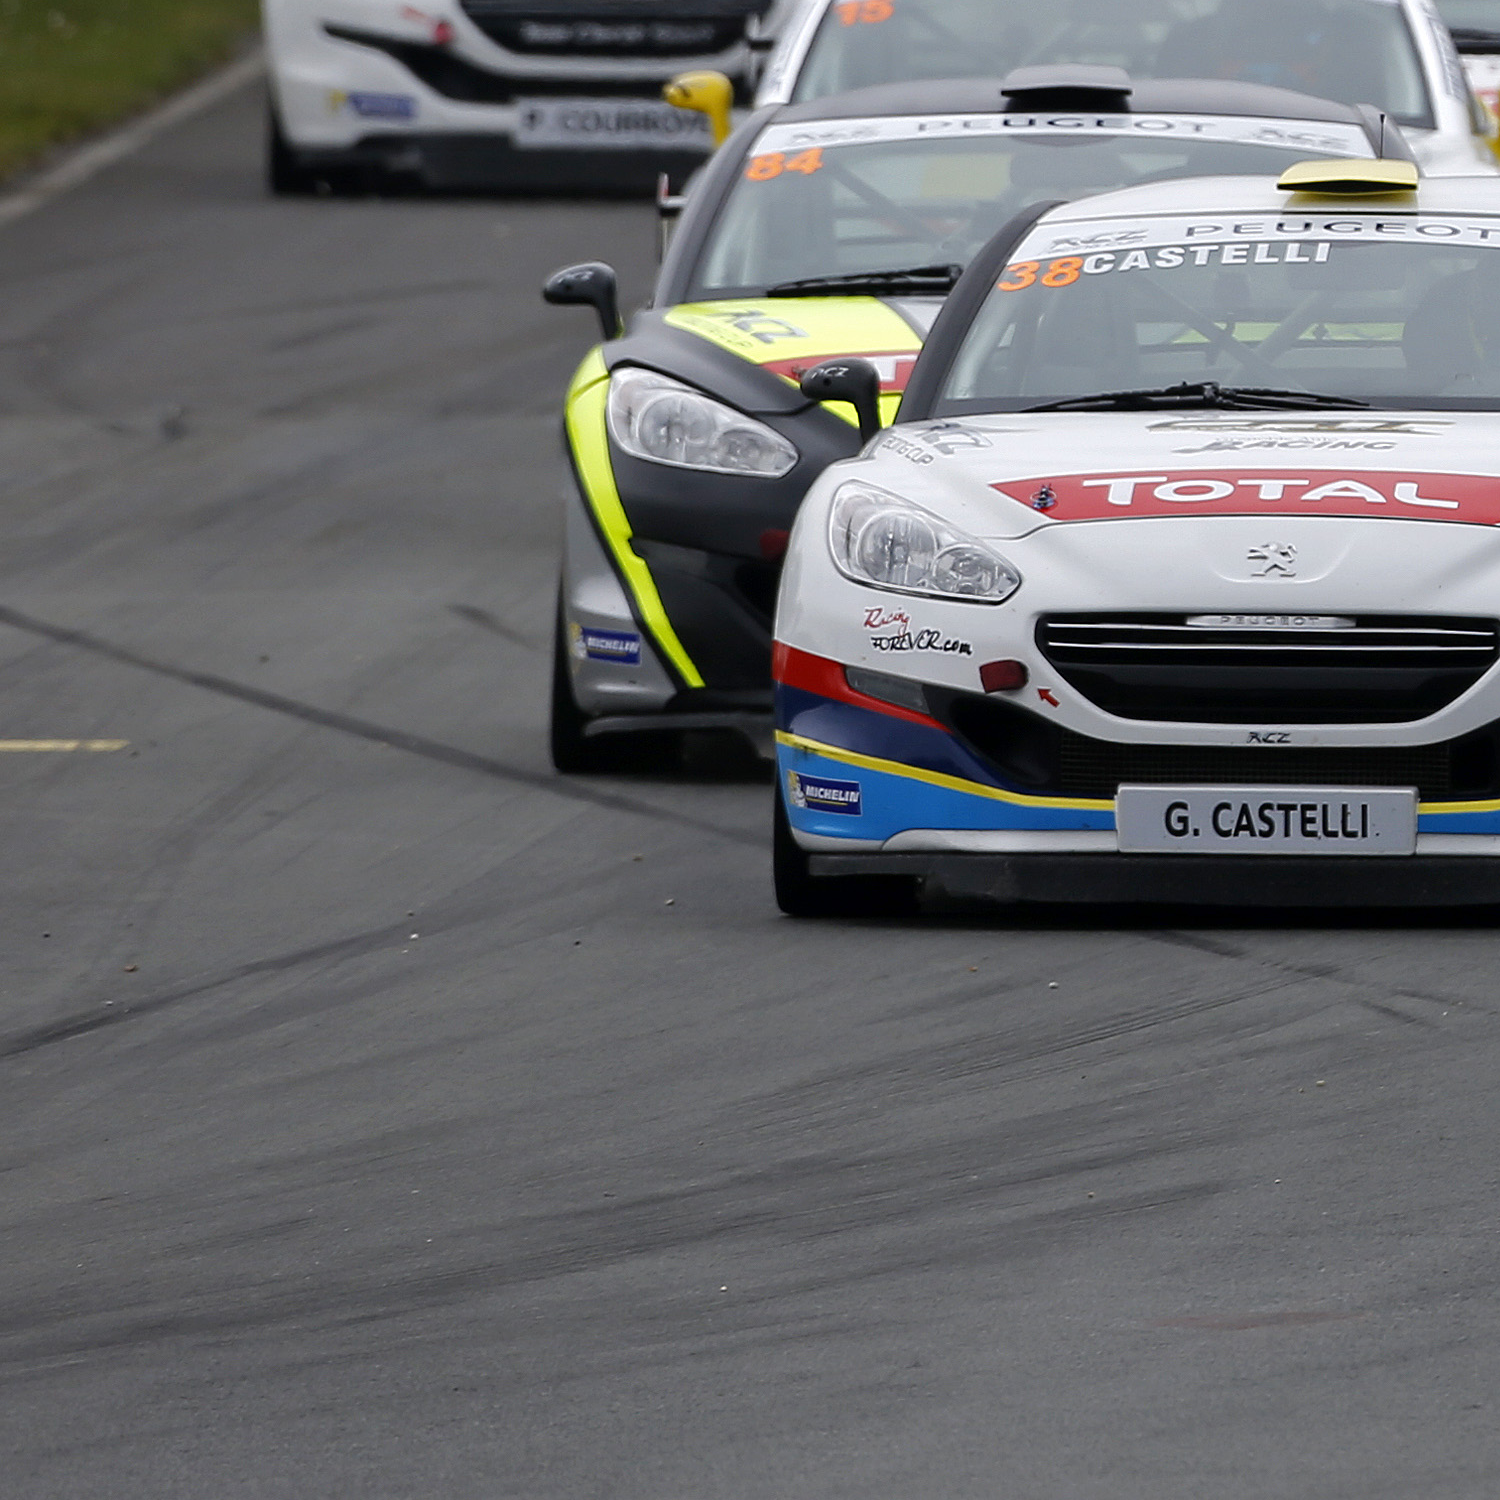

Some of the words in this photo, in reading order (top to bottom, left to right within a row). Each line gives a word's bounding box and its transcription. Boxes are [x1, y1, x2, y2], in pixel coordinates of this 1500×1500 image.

[917, 113, 1219, 136] PEUGEOT
[746, 148, 823, 183] 84
[998, 257, 1082, 293] 38
[1082, 243, 1331, 275] CASTELLI
[1083, 476, 1460, 509] TOTAL
[863, 606, 910, 638] Racing
[1220, 616, 1320, 626] PEUGEOT
[586, 635, 641, 653] MICHELIN
[1246, 731, 1291, 744] RCZ
[805, 784, 860, 803] MICHELIN
[1164, 801, 1201, 838] G.
[1211, 801, 1369, 839] CASTELLI
